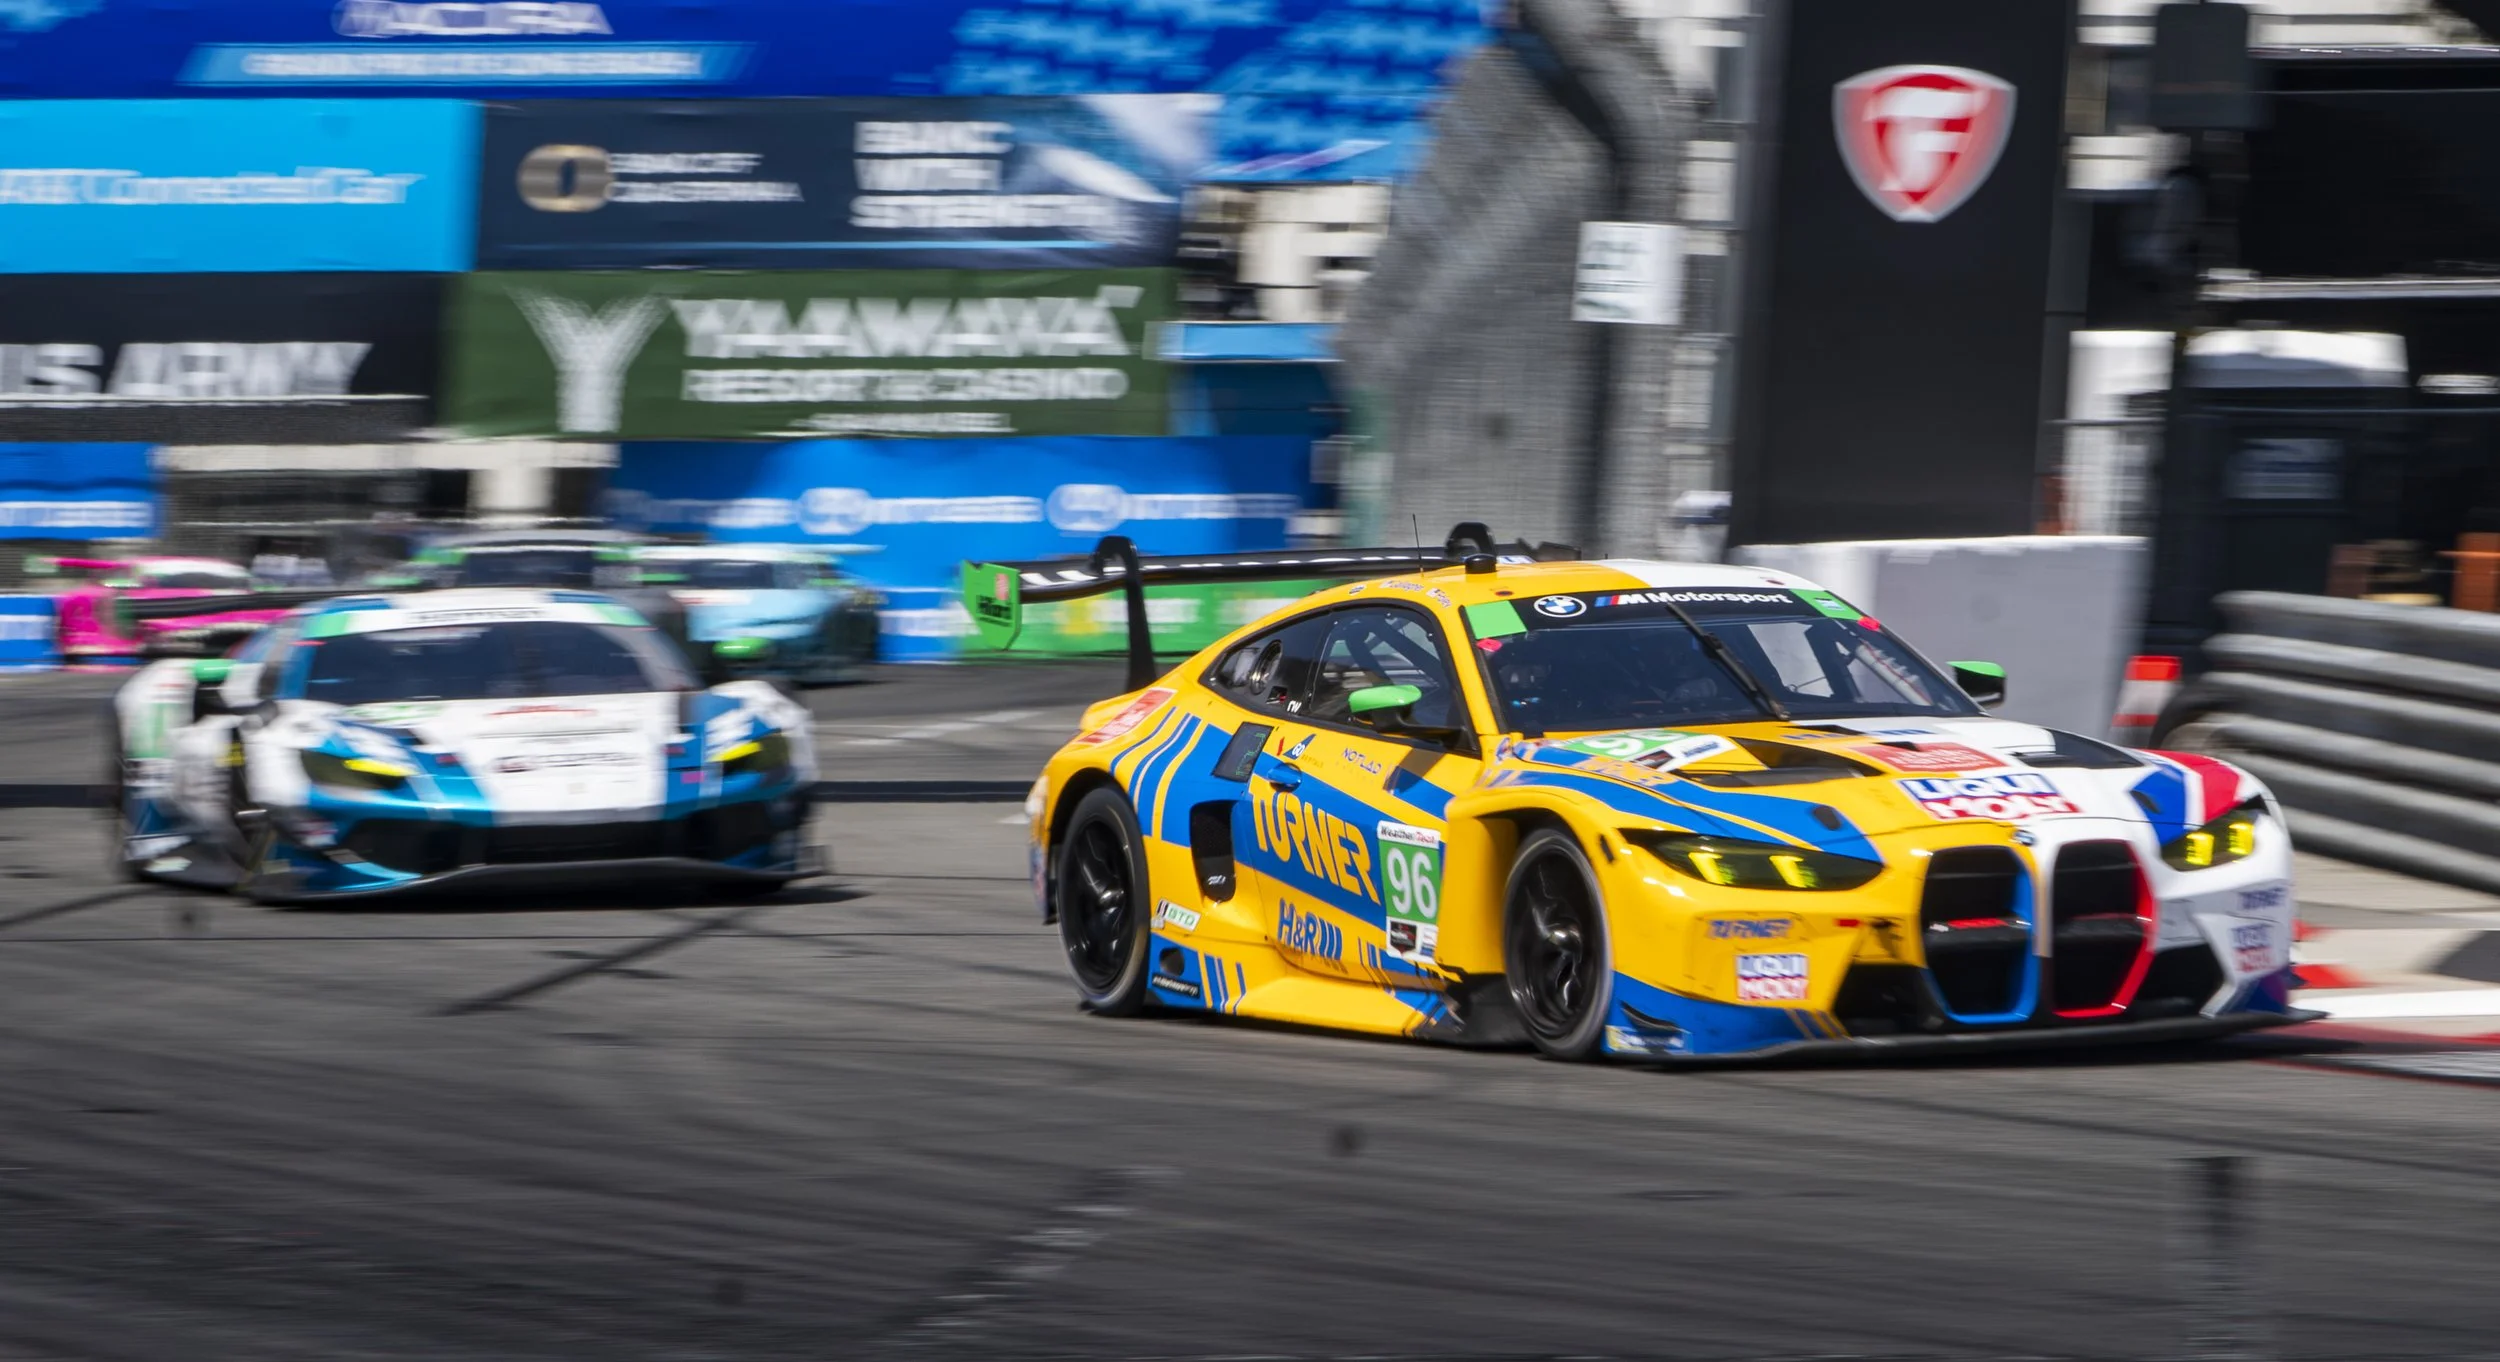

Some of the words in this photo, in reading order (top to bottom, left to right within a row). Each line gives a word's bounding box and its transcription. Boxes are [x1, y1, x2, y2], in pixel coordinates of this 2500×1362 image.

[1645, 592, 1793, 604] Motorsport
[1901, 774, 2058, 800] LIQUI
[1924, 796, 2082, 820] MOLY
[1249, 774, 1381, 905] TURNER
[1387, 847, 1437, 919] 96
